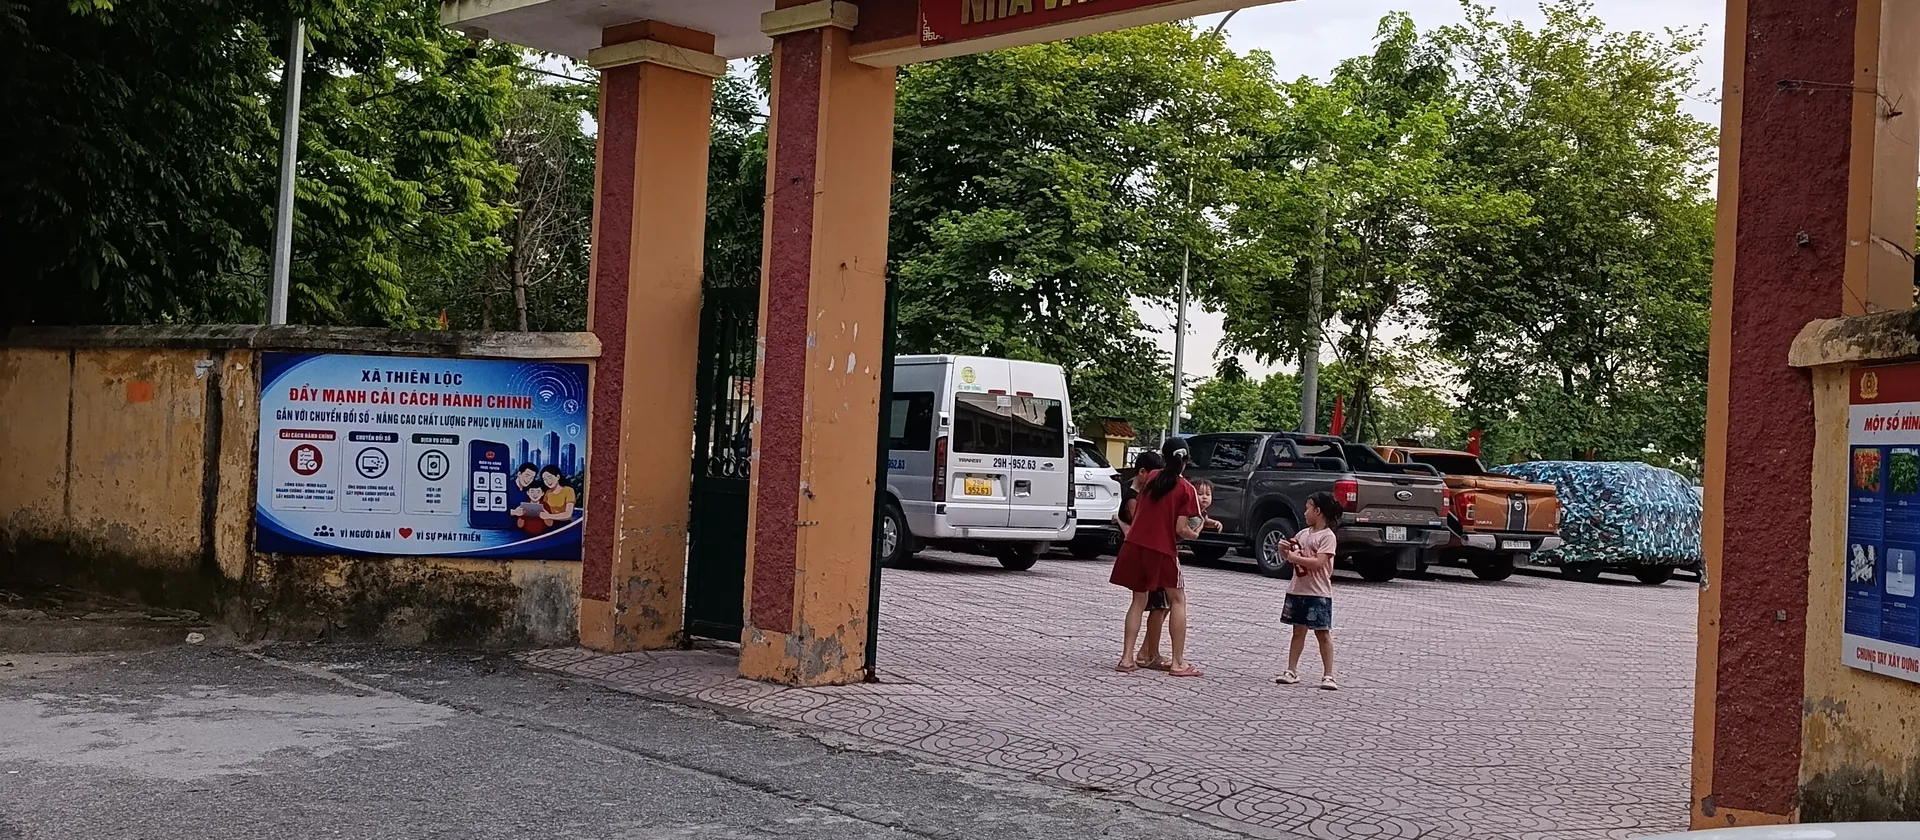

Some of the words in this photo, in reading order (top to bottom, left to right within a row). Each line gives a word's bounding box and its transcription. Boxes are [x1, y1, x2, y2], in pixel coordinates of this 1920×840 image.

[361, 369, 380, 383] XÃ
[385, 369, 430, 384] THIÊN
[434, 370, 463, 388] LỘC
[289, 383, 318, 401] ĐẨY
[322, 388, 366, 406] MẠNH
[370, 387, 396, 405] CẢI
[399, 389, 439, 406] CÁCH
[443, 390, 483, 407] HÀNH
[486, 393, 532, 409] CHÍNH
[276, 408, 293, 422] GẮN
[294, 409, 309, 422] VỚI
[310, 408, 342, 423] CHUYỂN
[343, 408, 357, 423] ĐỔI
[358, 409, 370, 424] SỐ
[376, 411, 398, 425] NÂNG
[400, 415, 416, 426] CAO
[417, 412, 439, 427] CHẤT
[440, 415, 466, 430] LƯỢNG
[467, 417, 490, 430] PHỤC
[491, 417, 502, 430] VỤ
[503, 416, 525, 429] NHÂN
[527, 416, 543, 430] DÂN
[1864, 413, 1885, 435] MỘT
[1886, 409, 1900, 431] SỐ
[1901, 411, 1920, 431] HÌN
[340, 528, 348, 538] VÌ
[349, 529, 374, 539] NGƯỜI
[375, 529, 391, 539] DÂN
[416, 530, 425, 540] VÌ
[425, 531, 436, 542] SỰ
[437, 531, 457, 541] PHÁT
[458, 530, 481, 542] TRIỂN
[1857, 646, 1876, 663] CHUNG
[1877, 651, 1887, 665] TAY
[1888, 652, 1901, 668] XÂY
[1901, 656, 1919, 674] DỰNG
